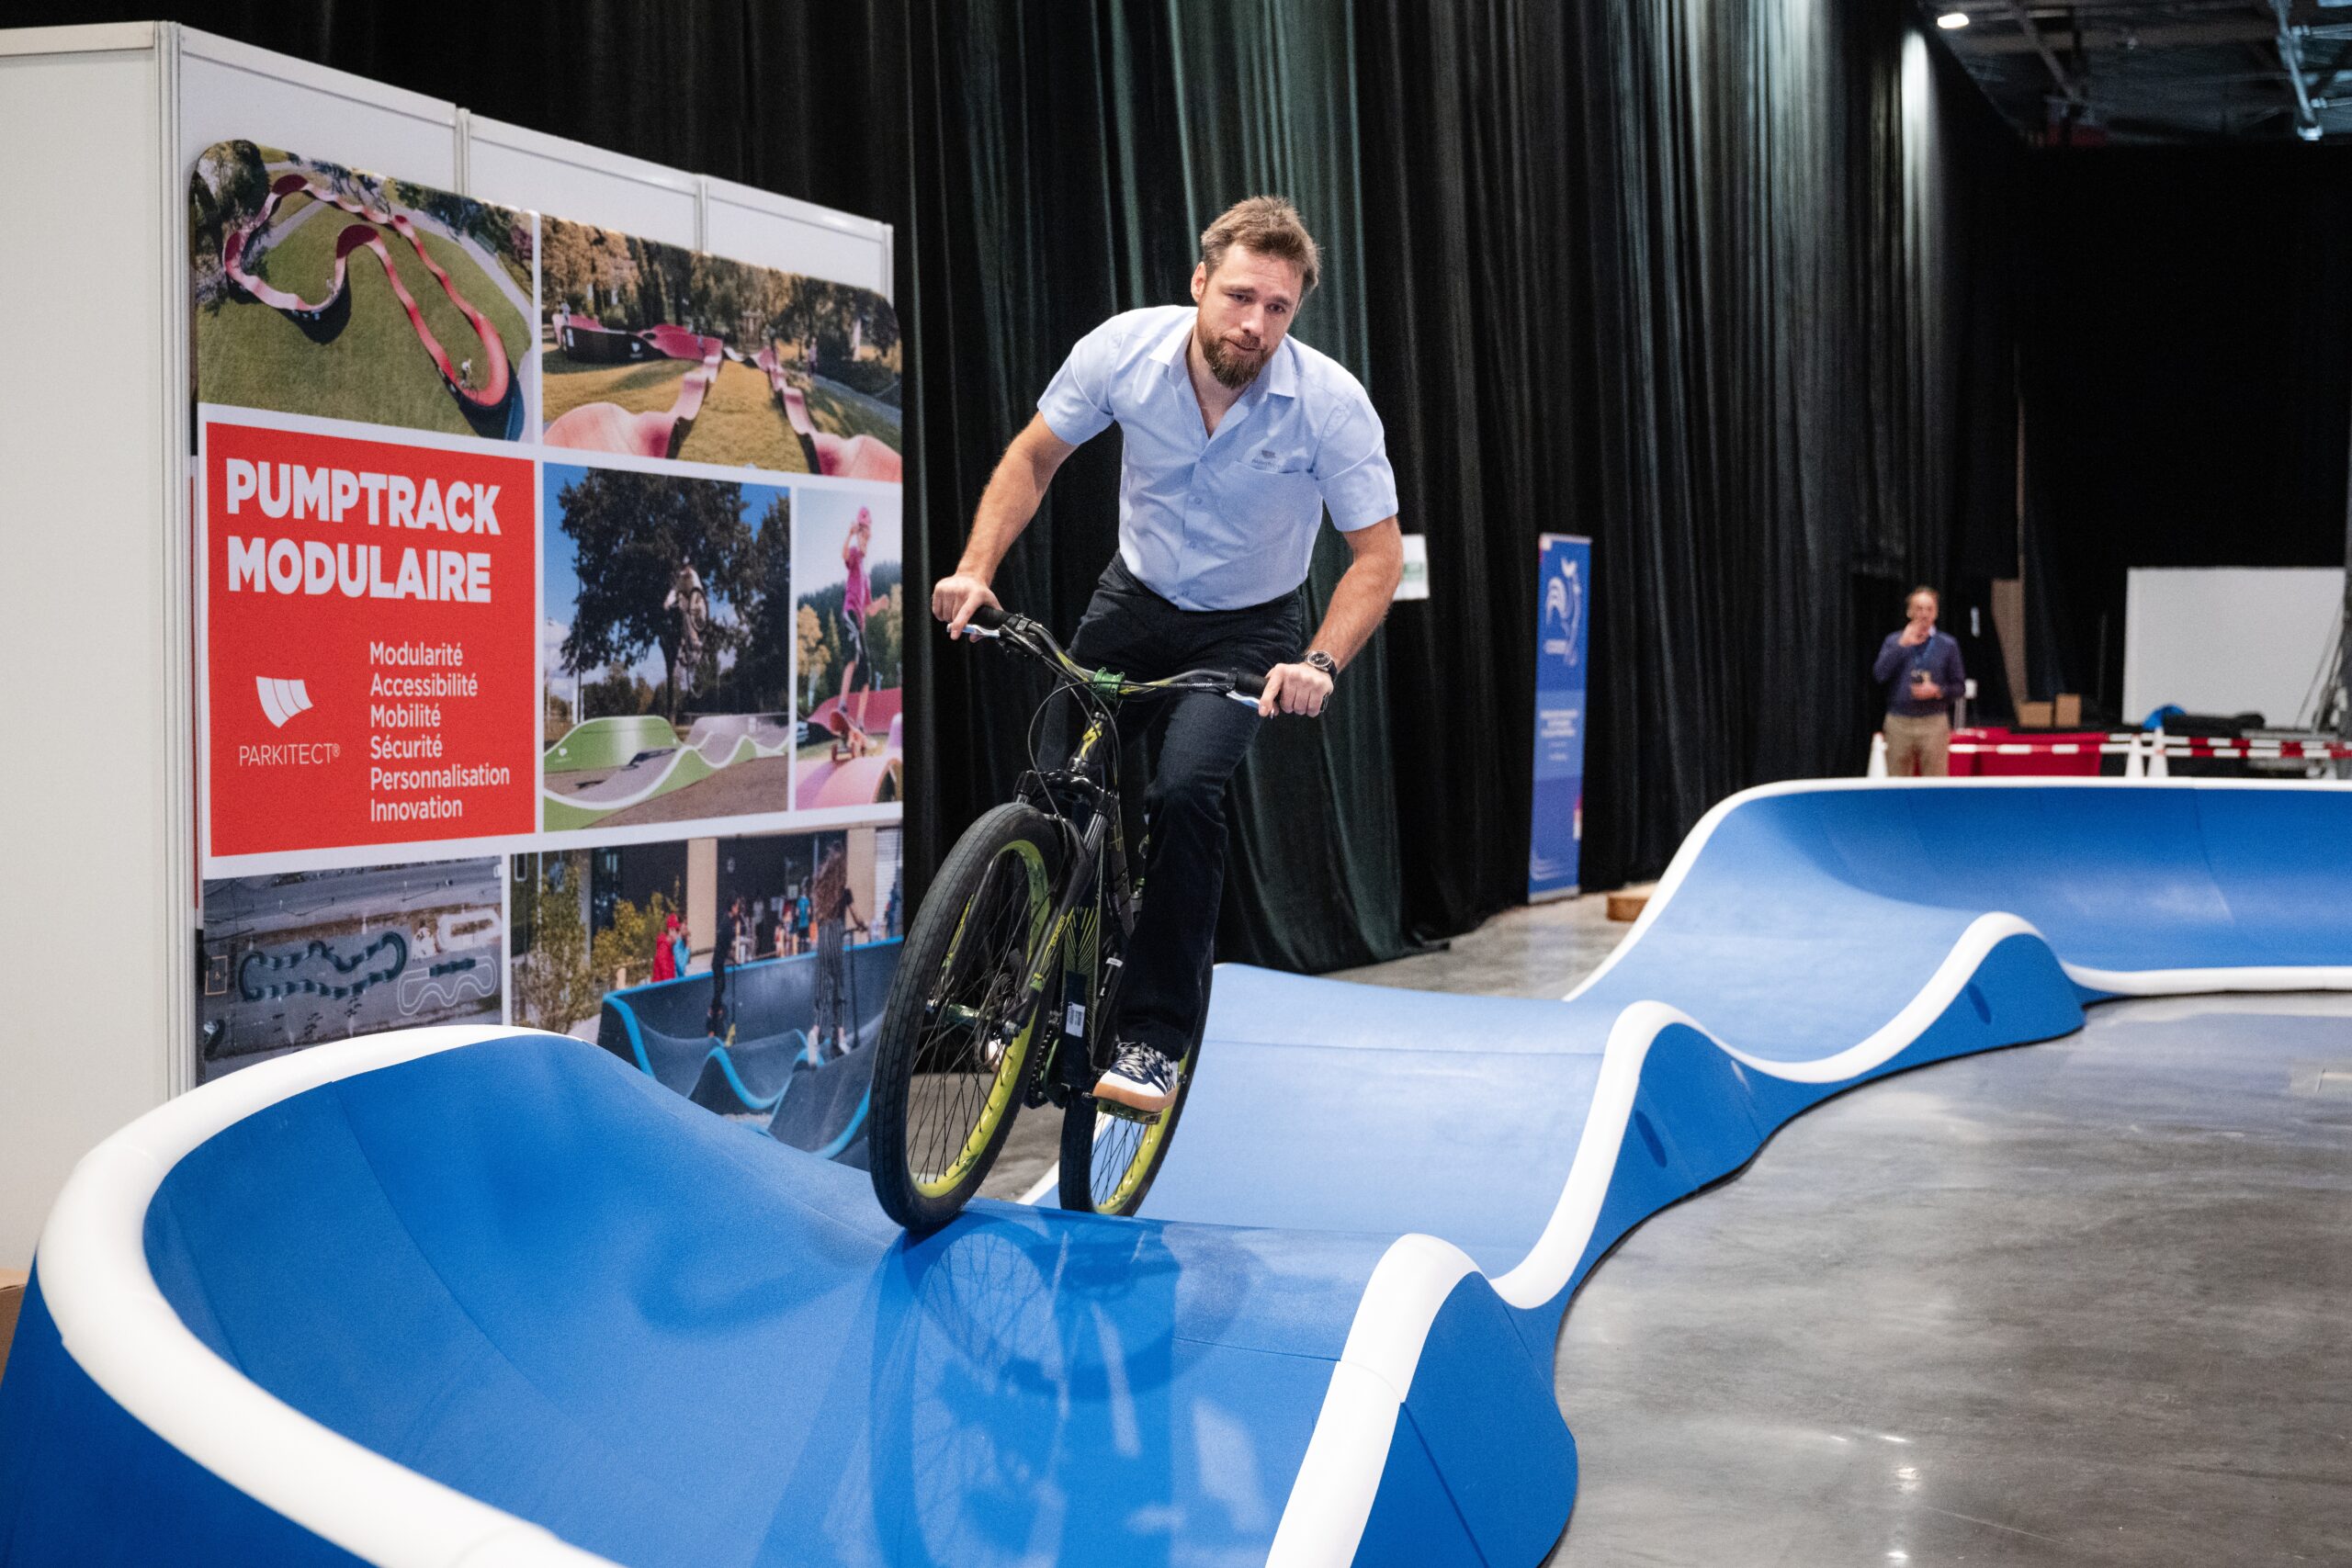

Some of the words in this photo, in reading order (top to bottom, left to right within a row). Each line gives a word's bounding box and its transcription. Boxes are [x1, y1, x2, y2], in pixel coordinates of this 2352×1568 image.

[226, 457, 502, 536] PUMPTRACK
[227, 536, 492, 604] MODULAIRE
[369, 640, 464, 667] Modularité
[369, 671, 479, 697] Accessibilité
[370, 702, 442, 728] Mobilité
[369, 732, 444, 761] Sécurité
[370, 761, 511, 791] Personnalisation
[370, 795, 463, 822] Innovation
